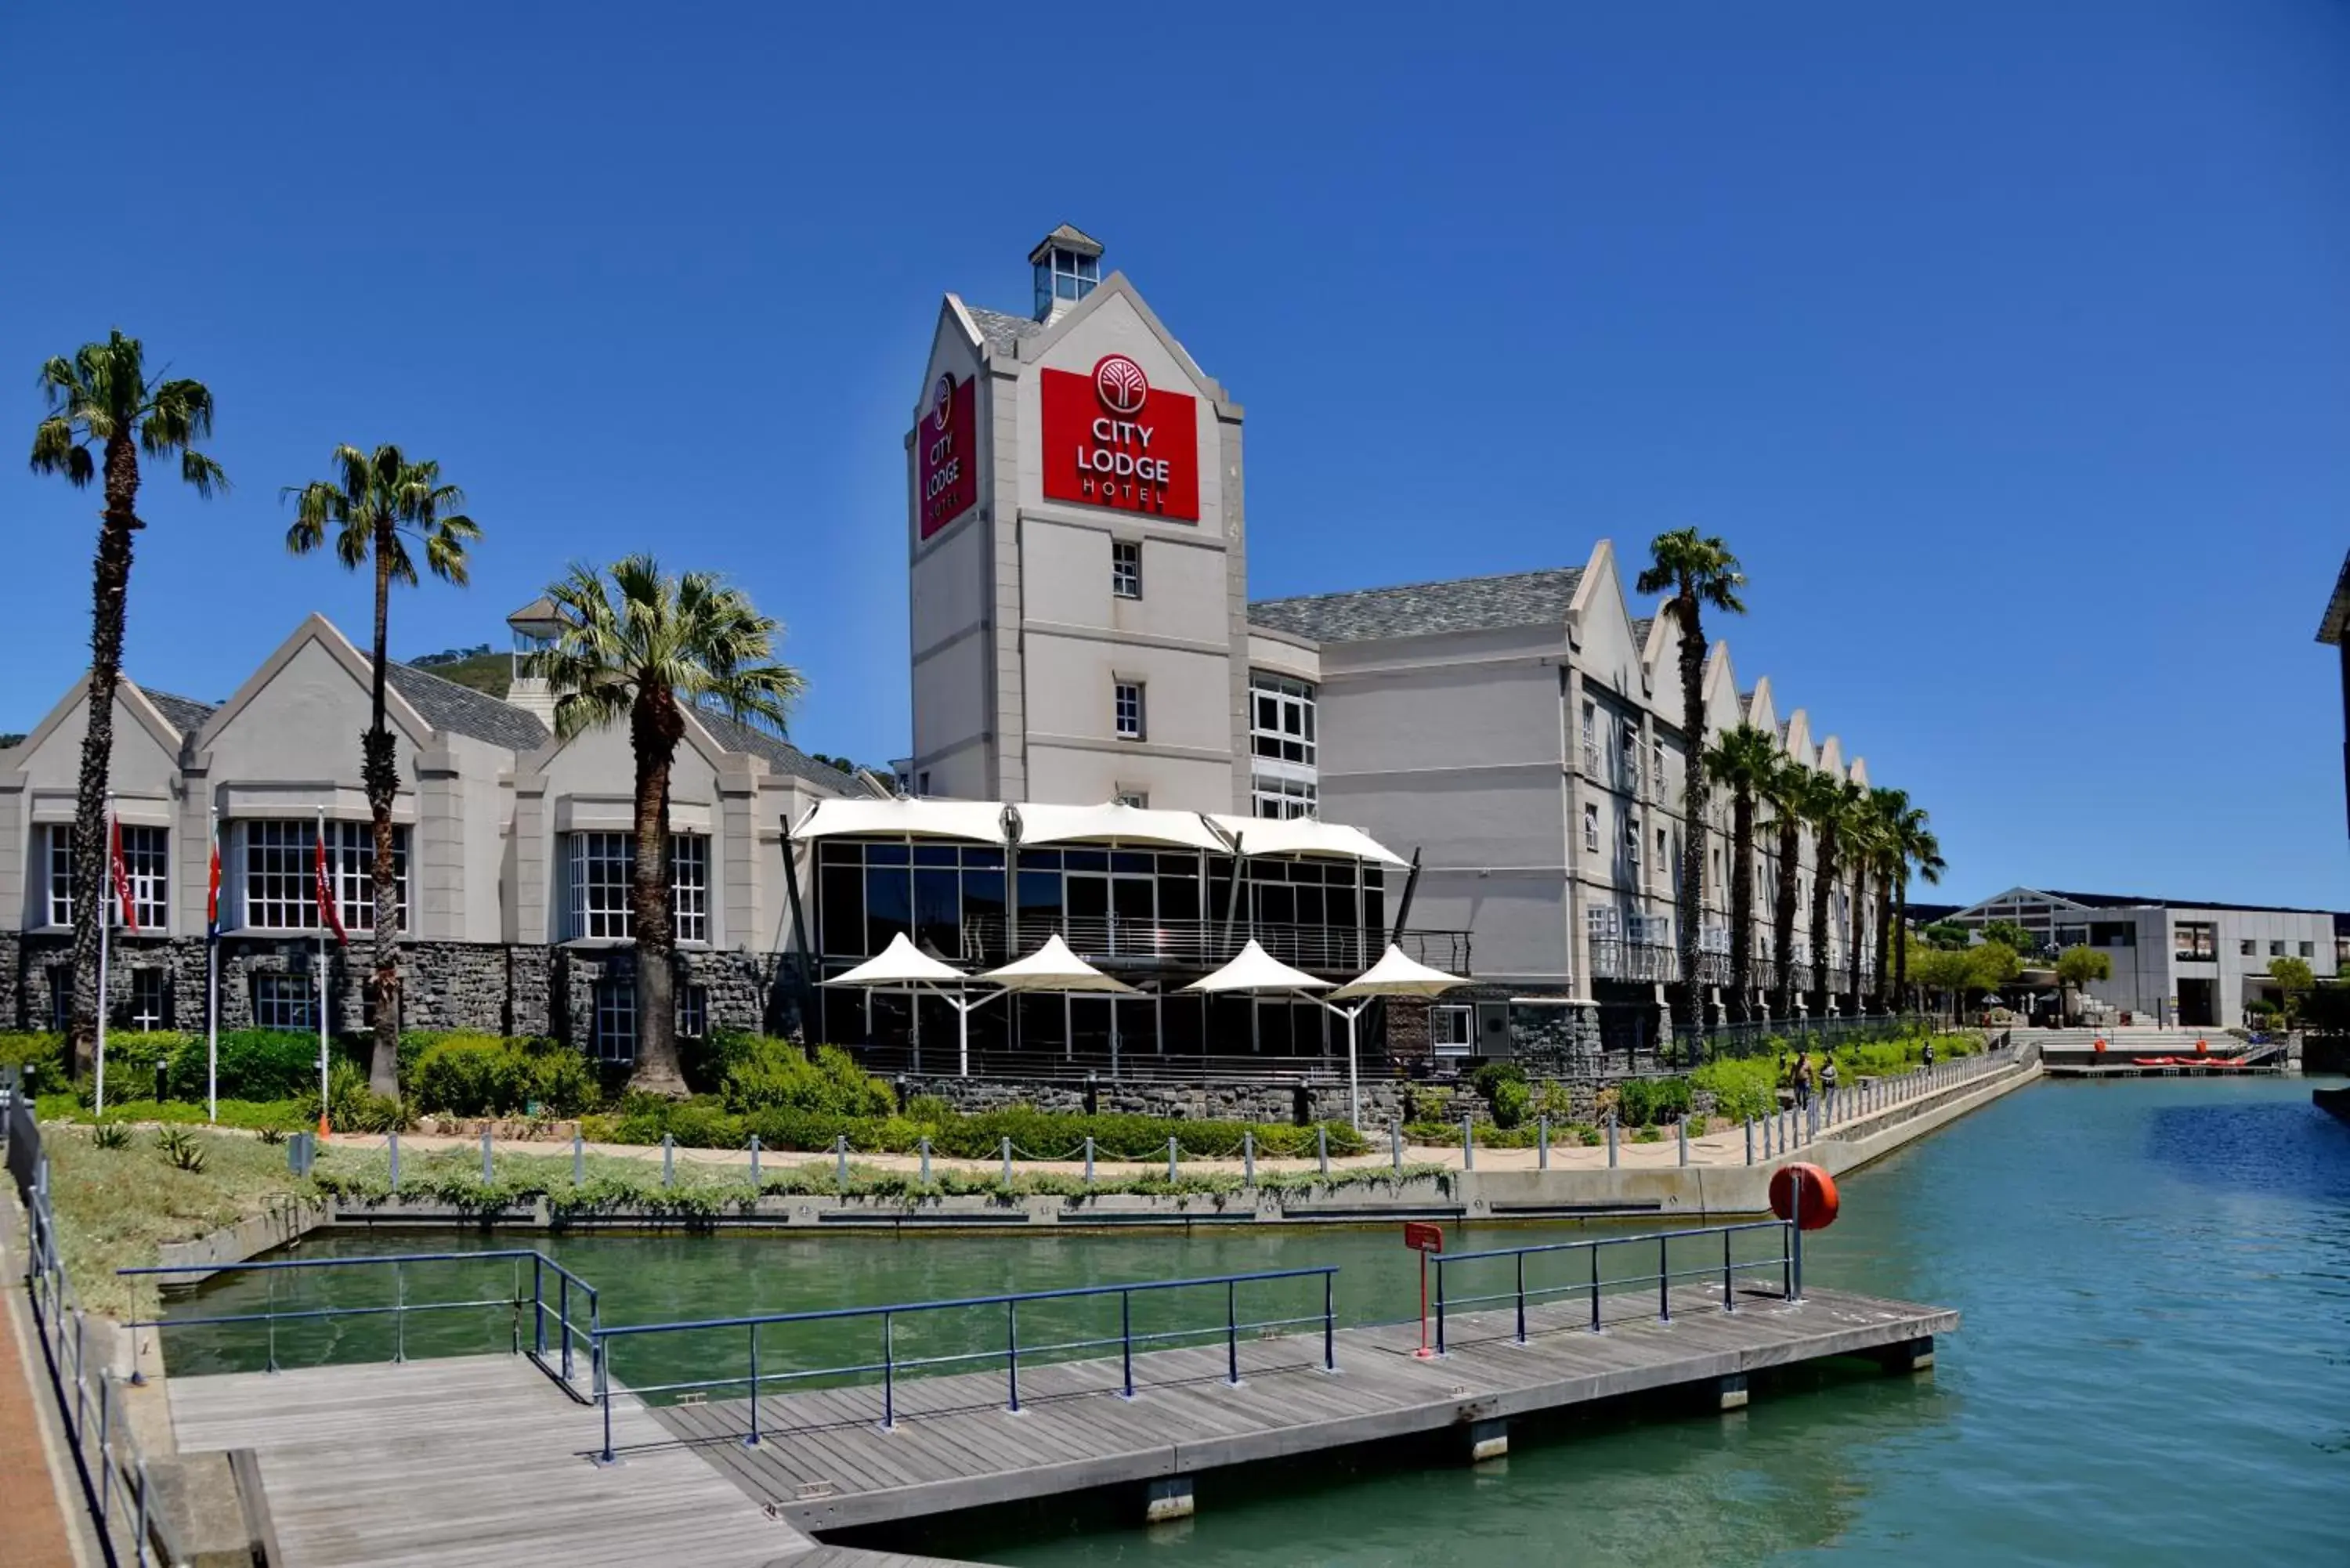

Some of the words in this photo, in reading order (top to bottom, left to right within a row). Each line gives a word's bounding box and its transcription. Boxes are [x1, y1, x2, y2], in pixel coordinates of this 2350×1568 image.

[930, 431, 953, 466] CITY
[1093, 417, 1154, 447] CITY
[927, 457, 960, 500] LODGE
[1078, 445, 1170, 482] LODGE
[1083, 479, 1165, 504] HOTEL
